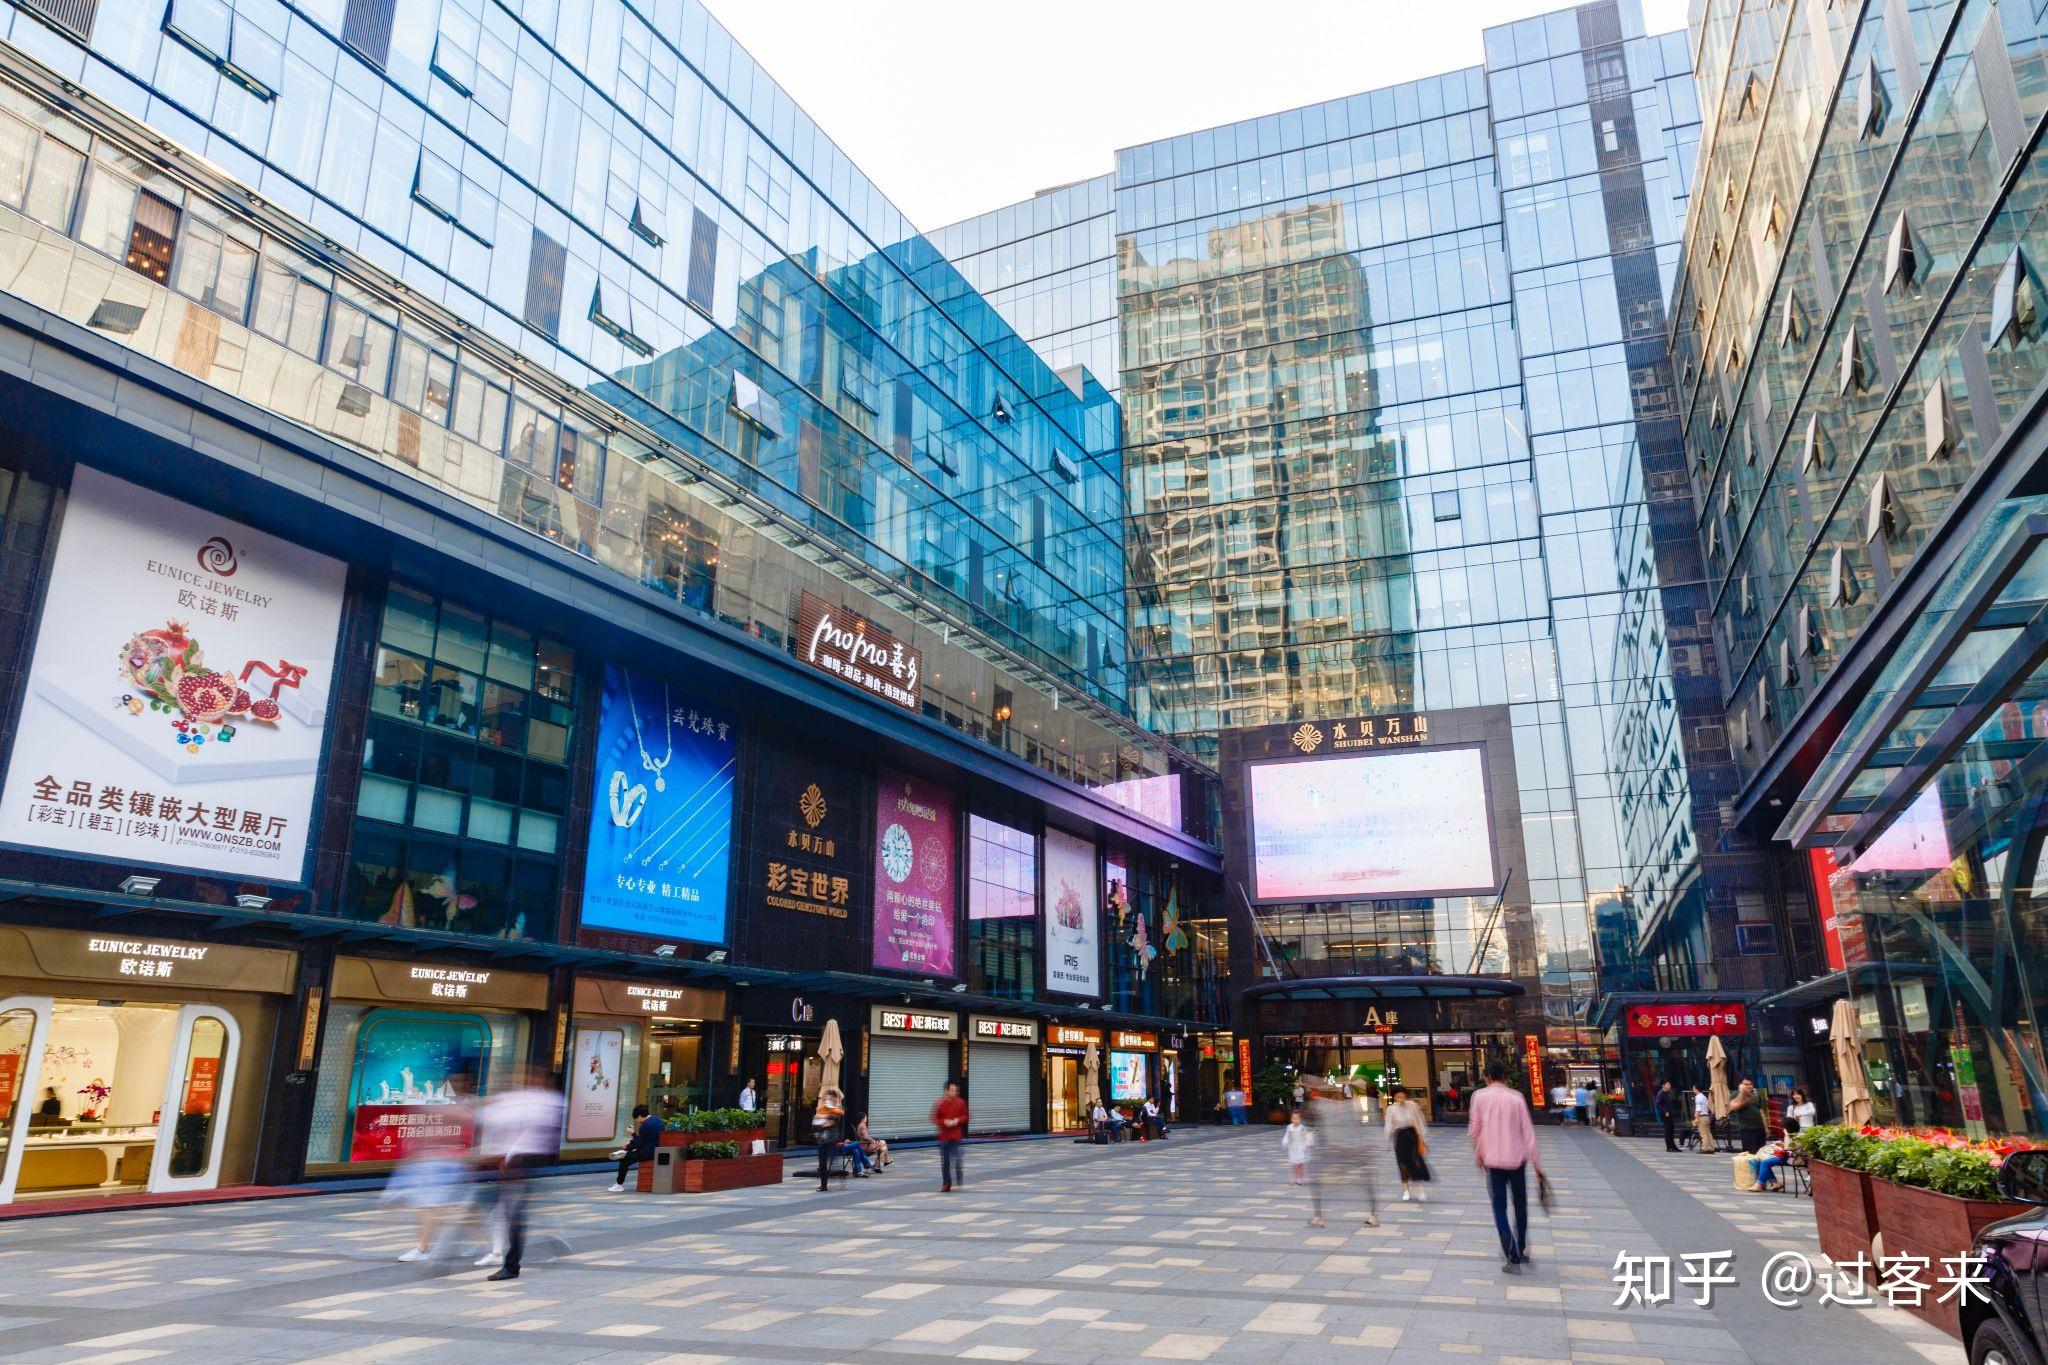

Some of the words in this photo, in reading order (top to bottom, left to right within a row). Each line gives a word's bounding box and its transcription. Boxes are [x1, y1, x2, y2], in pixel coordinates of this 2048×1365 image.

[147, 560, 202, 587] EUNICE
[205, 579, 272, 608] JEWELRY
[178, 588, 239, 622] 欧诺斯
[1332, 716, 1428, 740] 水贝万山
[1334, 738, 1374, 748] SHUIBEI
[1378, 733, 1428, 745] WANSHAN
[33, 774, 288, 839] 全品类镶嵌大型展厅
[178, 826, 281, 852] WWW.ONSZB.COM
[616, 874, 657, 895] 专心专业
[662, 882, 700, 902] 精工精品
[767, 862, 849, 905] 彩宝世界
[88, 938, 142, 955] EUNICE
[143, 944, 208, 960] JEWELRY
[119, 958, 174, 977] 欧诺斯
[411, 967, 446, 980] EUNICE
[447, 970, 490, 983] JEWELRY
[432, 982, 467, 998] 欧诺斯
[627, 986, 652, 997] EUNICE
[652, 988, 684, 999] JEWELRY
[641, 998, 667, 1011] 欧诺斯
[1656, 1014, 1738, 1027] 万山美食广场
